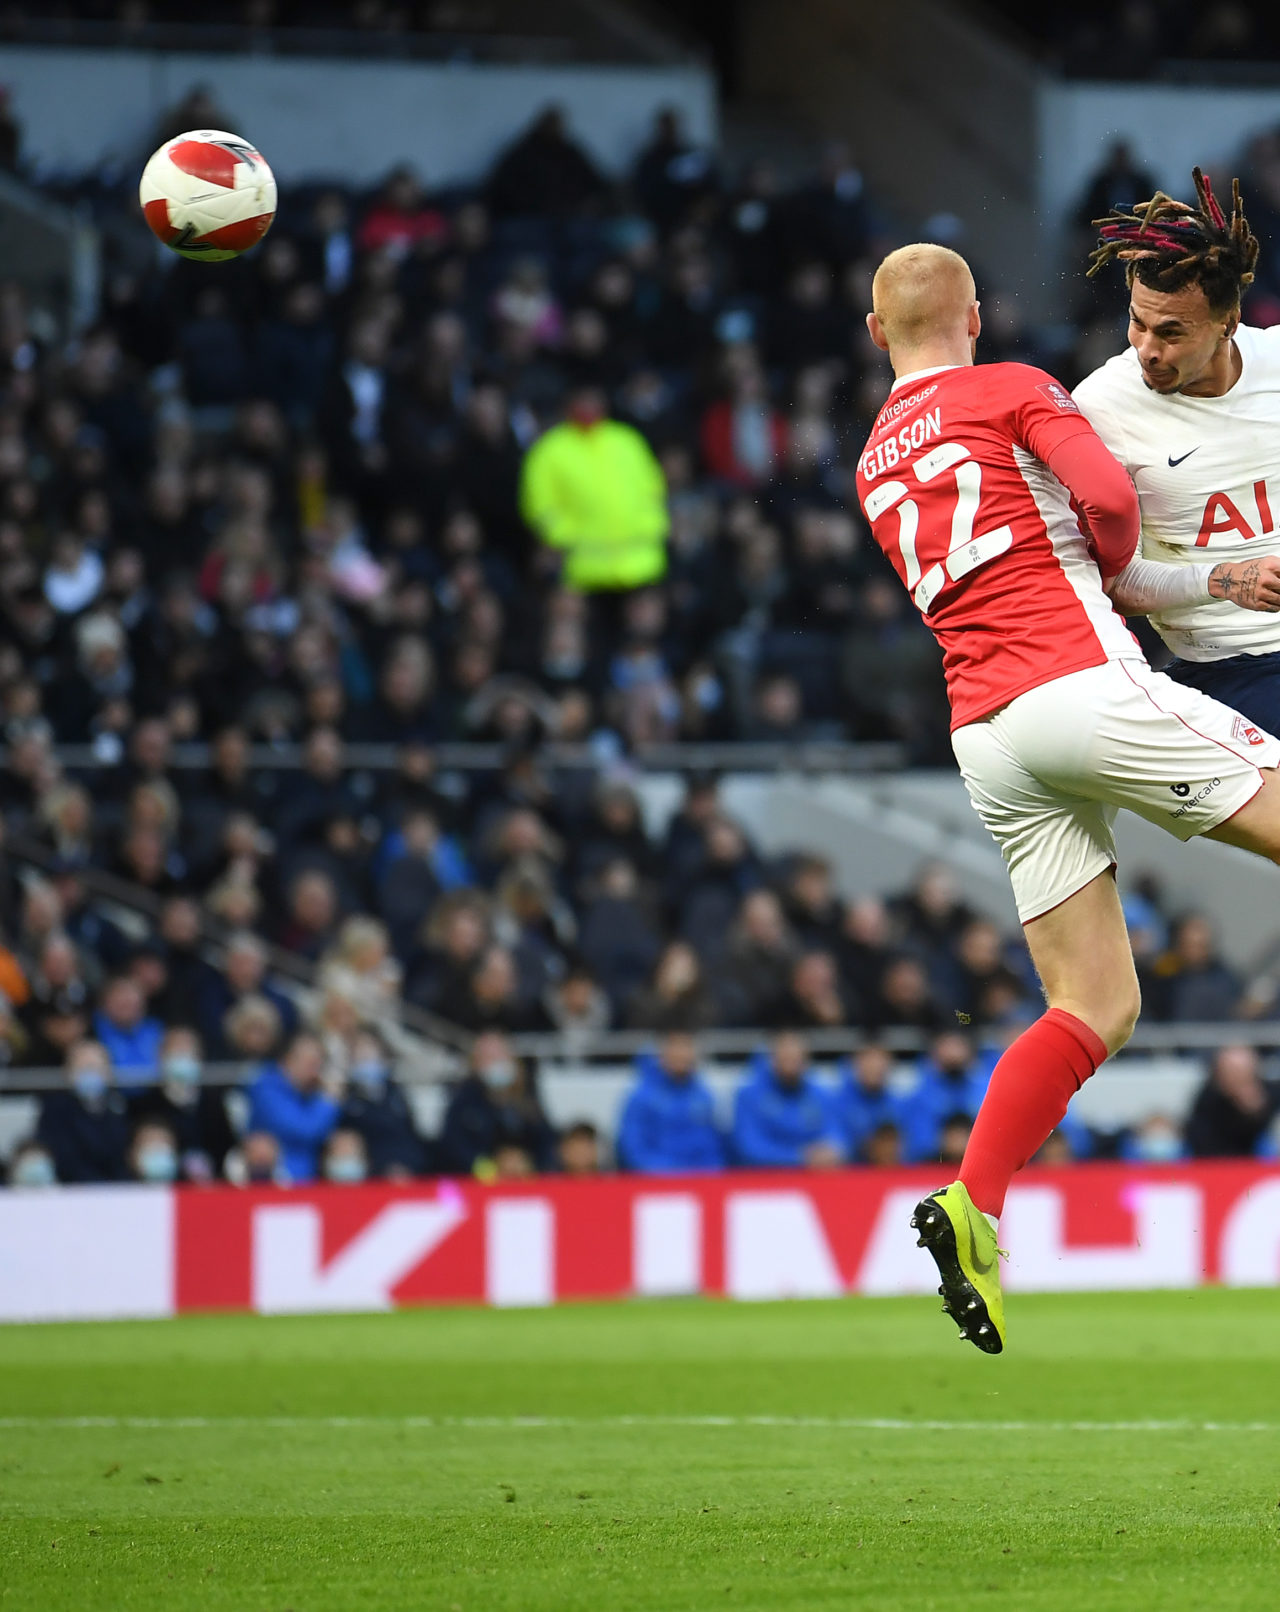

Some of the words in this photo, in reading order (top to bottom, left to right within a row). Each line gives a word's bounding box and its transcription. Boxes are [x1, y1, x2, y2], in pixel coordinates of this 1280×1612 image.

[862, 406, 941, 482] GIBSON
[864, 442, 1013, 614] 22
[1168, 776, 1221, 819] bartercard
